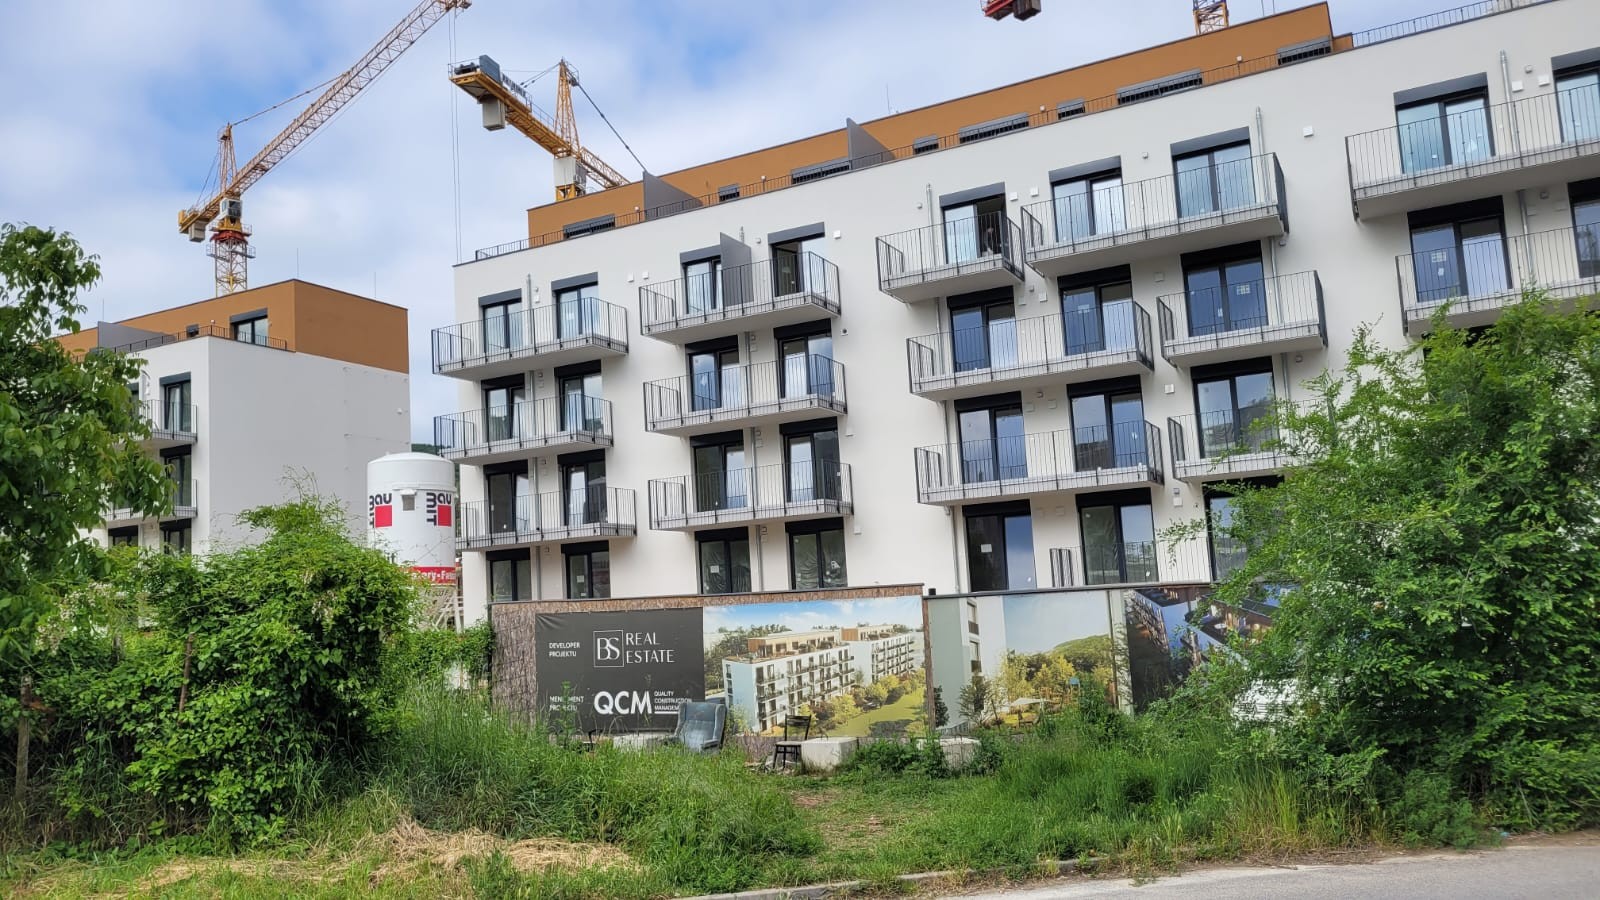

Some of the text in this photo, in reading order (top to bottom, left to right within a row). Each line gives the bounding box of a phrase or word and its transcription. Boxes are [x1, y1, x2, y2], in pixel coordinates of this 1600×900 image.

[549, 641, 581, 649] DEVELOPER
[625, 632, 660, 646] REAL
[549, 650, 577, 658] PROJEKTU
[596, 637, 620, 660] BS
[626, 649, 675, 664] ESTATE
[594, 690, 652, 715] QCM
